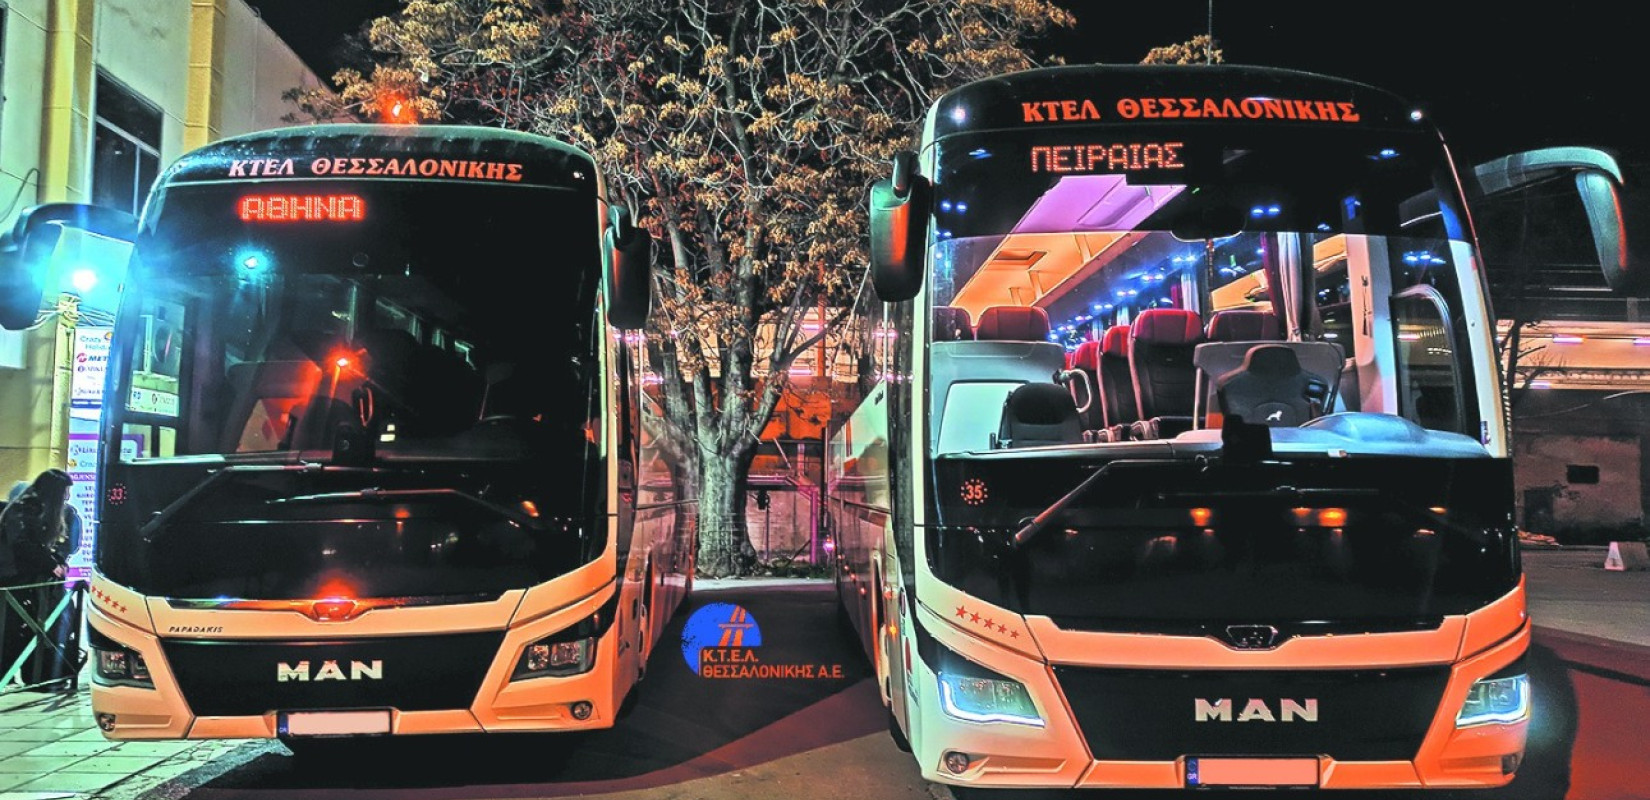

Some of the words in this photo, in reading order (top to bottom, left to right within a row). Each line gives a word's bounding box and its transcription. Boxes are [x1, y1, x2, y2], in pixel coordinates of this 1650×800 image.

[1023, 101, 1100, 122] ΚΤΕΛ
[1117, 98, 1360, 122] ΘΕΣΣΑΛΟΝΙΚΗΣ
[1031, 142, 1185, 172] ΠΕΙΡΑΙΑΣ
[229, 158, 295, 177] ΚΤΕΛ
[311, 158, 523, 181] ΘΕΣΣΑΛΟΝΙΚΗΣ
[241, 195, 362, 220] ΑΘΗΝΑ
[110, 488, 124, 500] 33
[965, 484, 983, 500] 35
[277, 660, 383, 682] MAN
[1195, 698, 1318, 722] MAN
